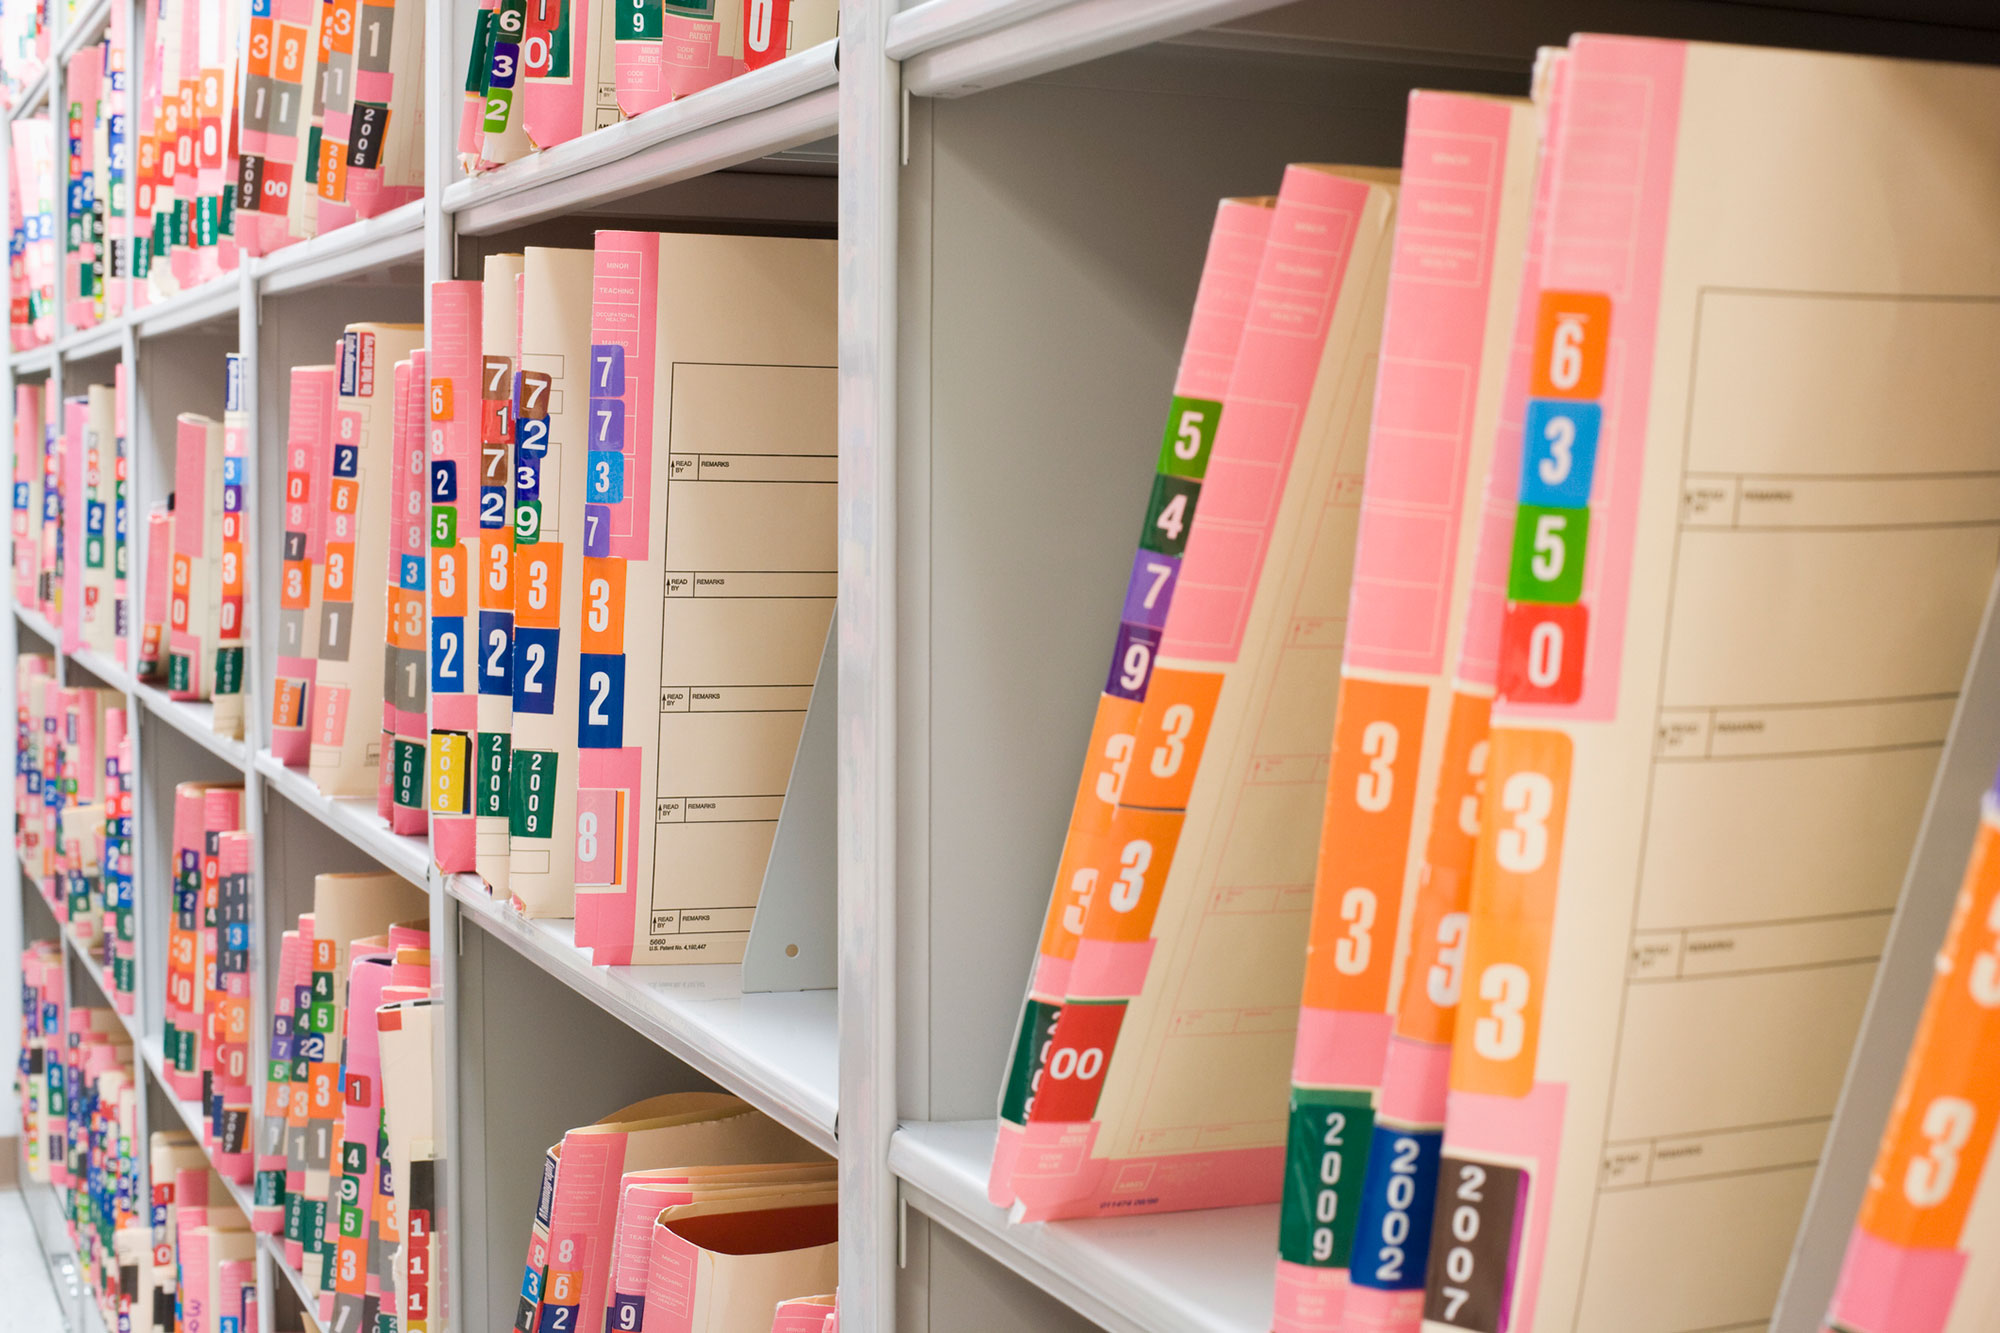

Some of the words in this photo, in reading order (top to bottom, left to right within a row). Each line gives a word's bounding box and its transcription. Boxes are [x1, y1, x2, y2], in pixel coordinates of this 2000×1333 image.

[334, 9, 351, 35] 3
[500, 10, 521, 31] 6
[693, 23, 712, 31] MINOR
[252, 34, 268, 59] 3
[369, 22, 380, 57] 1
[689, 32, 711, 40] PATIENT
[283, 39, 299, 70] 3
[492, 55, 513, 77] 3
[525, 37, 547, 68] 0
[335, 68, 344, 96] 1
[255, 87, 266, 119] 1
[279, 92, 289, 123] 1
[485, 99, 508, 121] 2
[178, 136, 192, 166] 0
[204, 125, 217, 156] 0
[354, 109, 375, 165] 2005
[243, 157, 255, 208] 2007
[326, 145, 338, 197] 2003
[264, 180, 288, 197] 00
[1550, 318, 1584, 390] 6
[486, 363, 508, 391] 7
[597, 357, 612, 387] 7
[432, 388, 443, 414] 6
[524, 379, 548, 408] 7
[341, 417, 353, 438] 8
[497, 406, 508, 436] 1
[522, 420, 547, 451] 2
[597, 411, 612, 441] 7
[1174, 410, 1204, 460] 5
[432, 429, 444, 455] 8
[1538, 416, 1576, 485] 3
[340, 450, 352, 471] 2
[411, 450, 423, 474] 8
[483, 449, 505, 477] 7
[291, 478, 302, 498] 0
[437, 469, 448, 495] 2
[517, 467, 535, 489] 3
[595, 462, 610, 493] 3
[225, 489, 236, 509] 9
[408, 490, 421, 514] 8
[480, 493, 504, 522] 2
[224, 517, 235, 537] 0
[436, 514, 448, 539] 5
[516, 506, 538, 536] 9
[587, 516, 598, 546] 7
[1157, 494, 1188, 540] 4
[290, 537, 298, 556] 1
[409, 526, 420, 548] 8
[1531, 515, 1567, 582] 5
[223, 552, 236, 584] 3
[328, 553, 344, 589] 3
[406, 562, 418, 583] 3
[439, 554, 455, 597] 3
[489, 544, 508, 591] 3
[288, 569, 302, 598] 3
[529, 561, 548, 609] 3
[1143, 562, 1172, 610] 7
[222, 602, 235, 630] 0
[406, 601, 422, 636] 3
[588, 578, 610, 632] 3
[329, 613, 339, 645] 1
[439, 632, 457, 677] 2
[487, 629, 507, 677] 2
[1120, 643, 1150, 691] 9
[1528, 621, 1563, 688] 0
[405, 662, 417, 698] 1
[524, 644, 545, 693] 2
[589, 671, 610, 725] 2
[324, 689, 338, 743] 2008
[1150, 704, 1194, 778] 3
[402, 745, 413, 803] 2009
[438, 737, 450, 808] 2006
[490, 735, 502, 811] 2009
[1355, 721, 1399, 812] 3
[527, 754, 542, 832] 2009
[578, 812, 597, 862] 8
[1496, 771, 1553, 874] 3
[188, 871, 196, 886] 4
[1109, 839, 1153, 913] 3
[184, 893, 194, 909] 2
[232, 928, 242, 945] 3
[1334, 887, 1378, 975] 3
[180, 939, 192, 963] 3
[179, 979, 191, 1005] 0
[316, 976, 327, 995] 4
[232, 1007, 245, 1033] 3
[317, 1008, 328, 1027] 5
[1474, 963, 1529, 1062] 3
[230, 1051, 243, 1077] 0
[1050, 1048, 1103, 1080] 00
[316, 1075, 329, 1107] 3
[352, 1080, 360, 1101] 1
[317, 1128, 326, 1158] 1
[1904, 1097, 1976, 1209] 3
[348, 1149, 360, 1168] 4
[1313, 1112, 1346, 1261] 2009
[343, 1213, 355, 1232] 5
[1376, 1137, 1420, 1281] 2002
[314, 1202, 325, 1252] 2009
[410, 1218, 424, 1237] 1
[157, 1247, 170, 1262] 0
[558, 1239, 574, 1263] 8
[1442, 1165, 1486, 1321] 2007
[341, 1250, 356, 1281] 3
[410, 1256, 424, 1275] 1
[528, 1272, 538, 1295] 3
[554, 1276, 569, 1299] 6
[409, 1294, 422, 1311] 1
[620, 1305, 636, 1330] 9
[552, 1307, 569, 1330] 2
